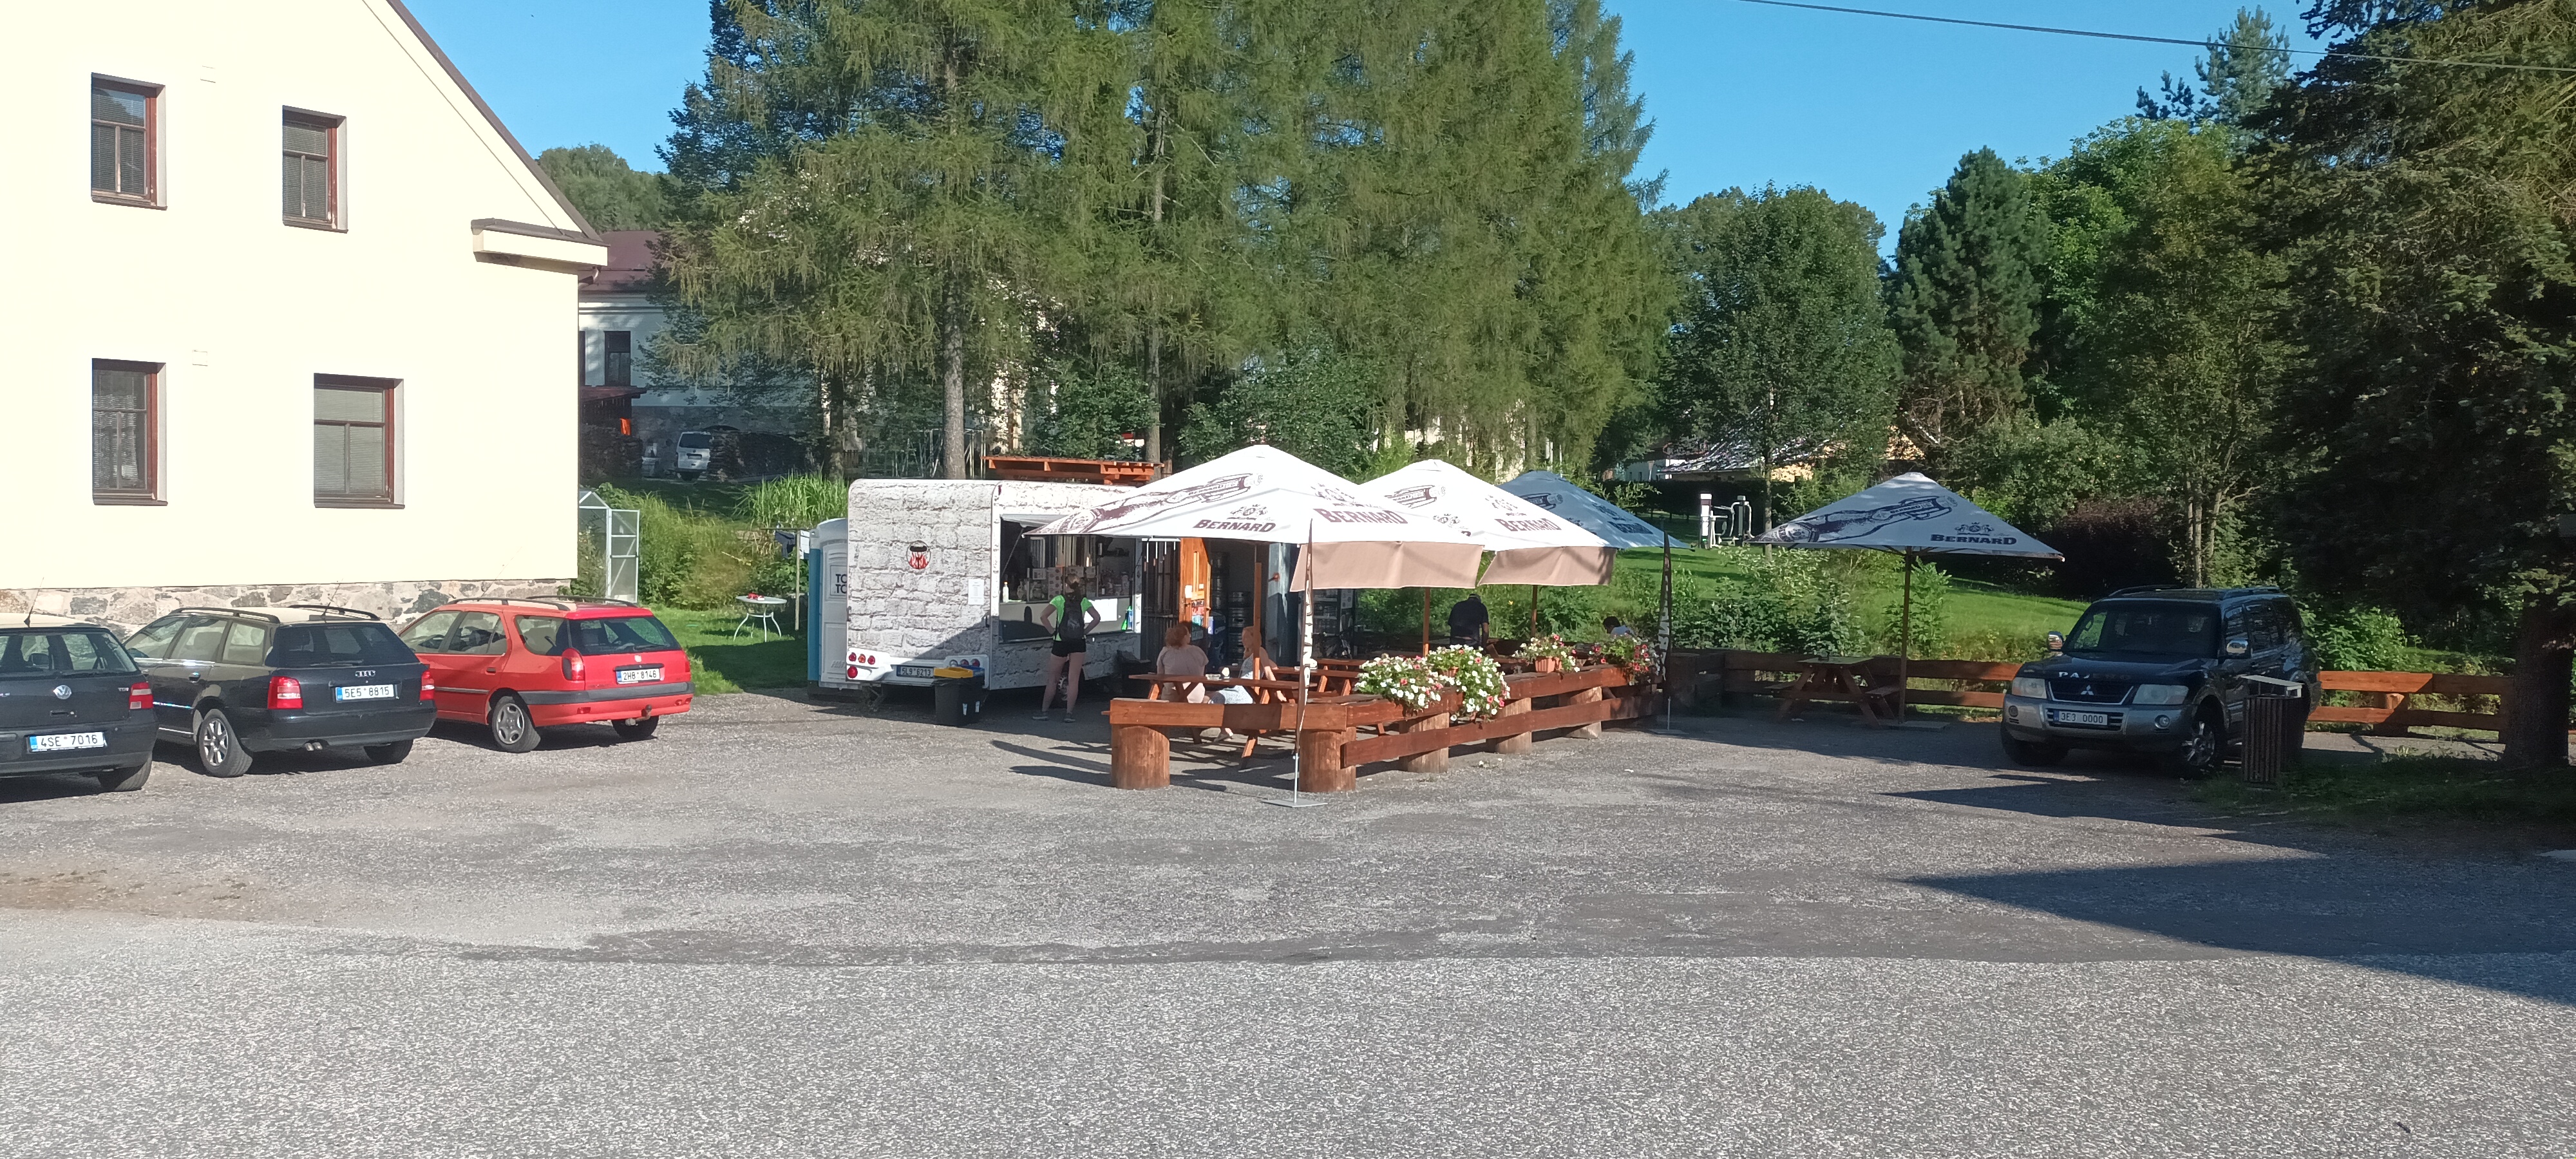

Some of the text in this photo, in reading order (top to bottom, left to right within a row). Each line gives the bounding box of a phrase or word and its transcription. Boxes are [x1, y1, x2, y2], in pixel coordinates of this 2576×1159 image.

[1312, 508, 1408, 524] BERNARD
[1193, 520, 1276, 532] BERNARD
[1494, 518, 1562, 532] BERNARD
[1930, 534, 2017, 545] BERNARD
[835, 574, 848, 583] TO
[835, 584, 848, 594] TO
[345, 686, 390, 698] 5E5 8815
[2061, 712, 2103, 724] 3E3 0000
[41, 734, 98, 747] 4SE 7016
